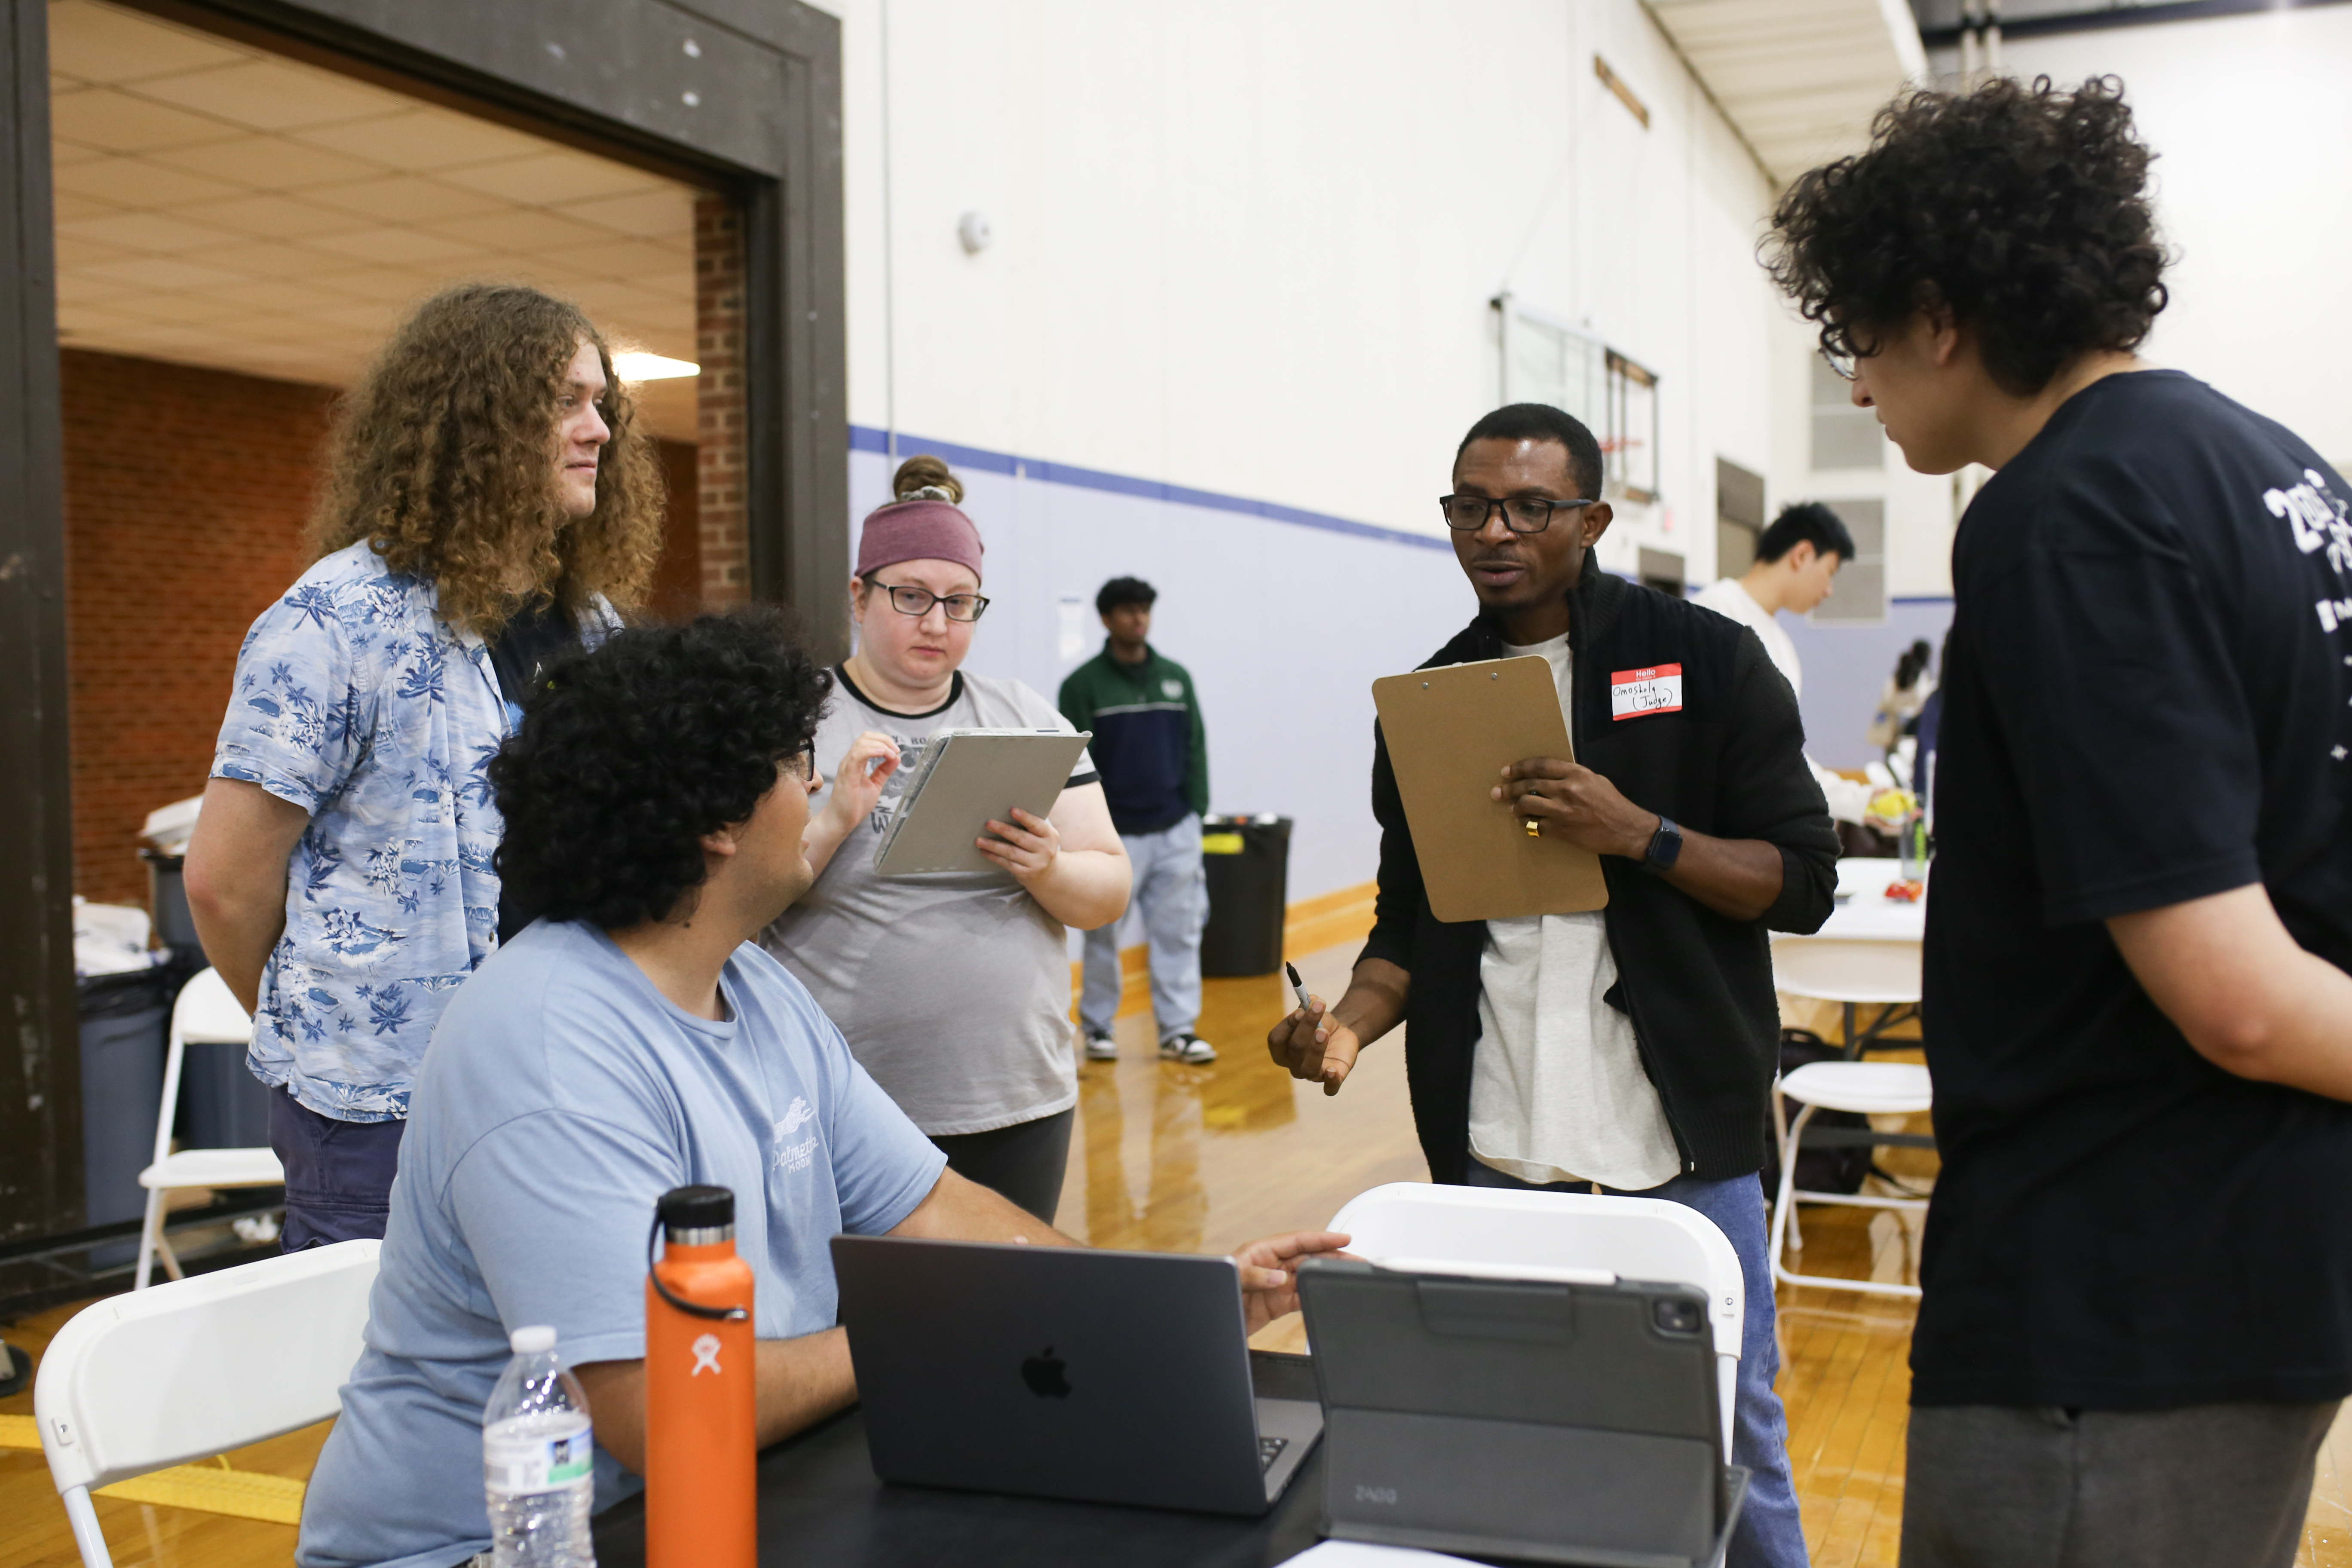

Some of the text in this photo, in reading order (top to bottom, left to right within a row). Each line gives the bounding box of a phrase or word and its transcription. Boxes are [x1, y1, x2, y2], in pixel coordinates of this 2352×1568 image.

[1636, 669, 1656, 678] Hello
[1632, 687, 1673, 711] (Judge)
[787, 1155, 811, 1174] MOON
